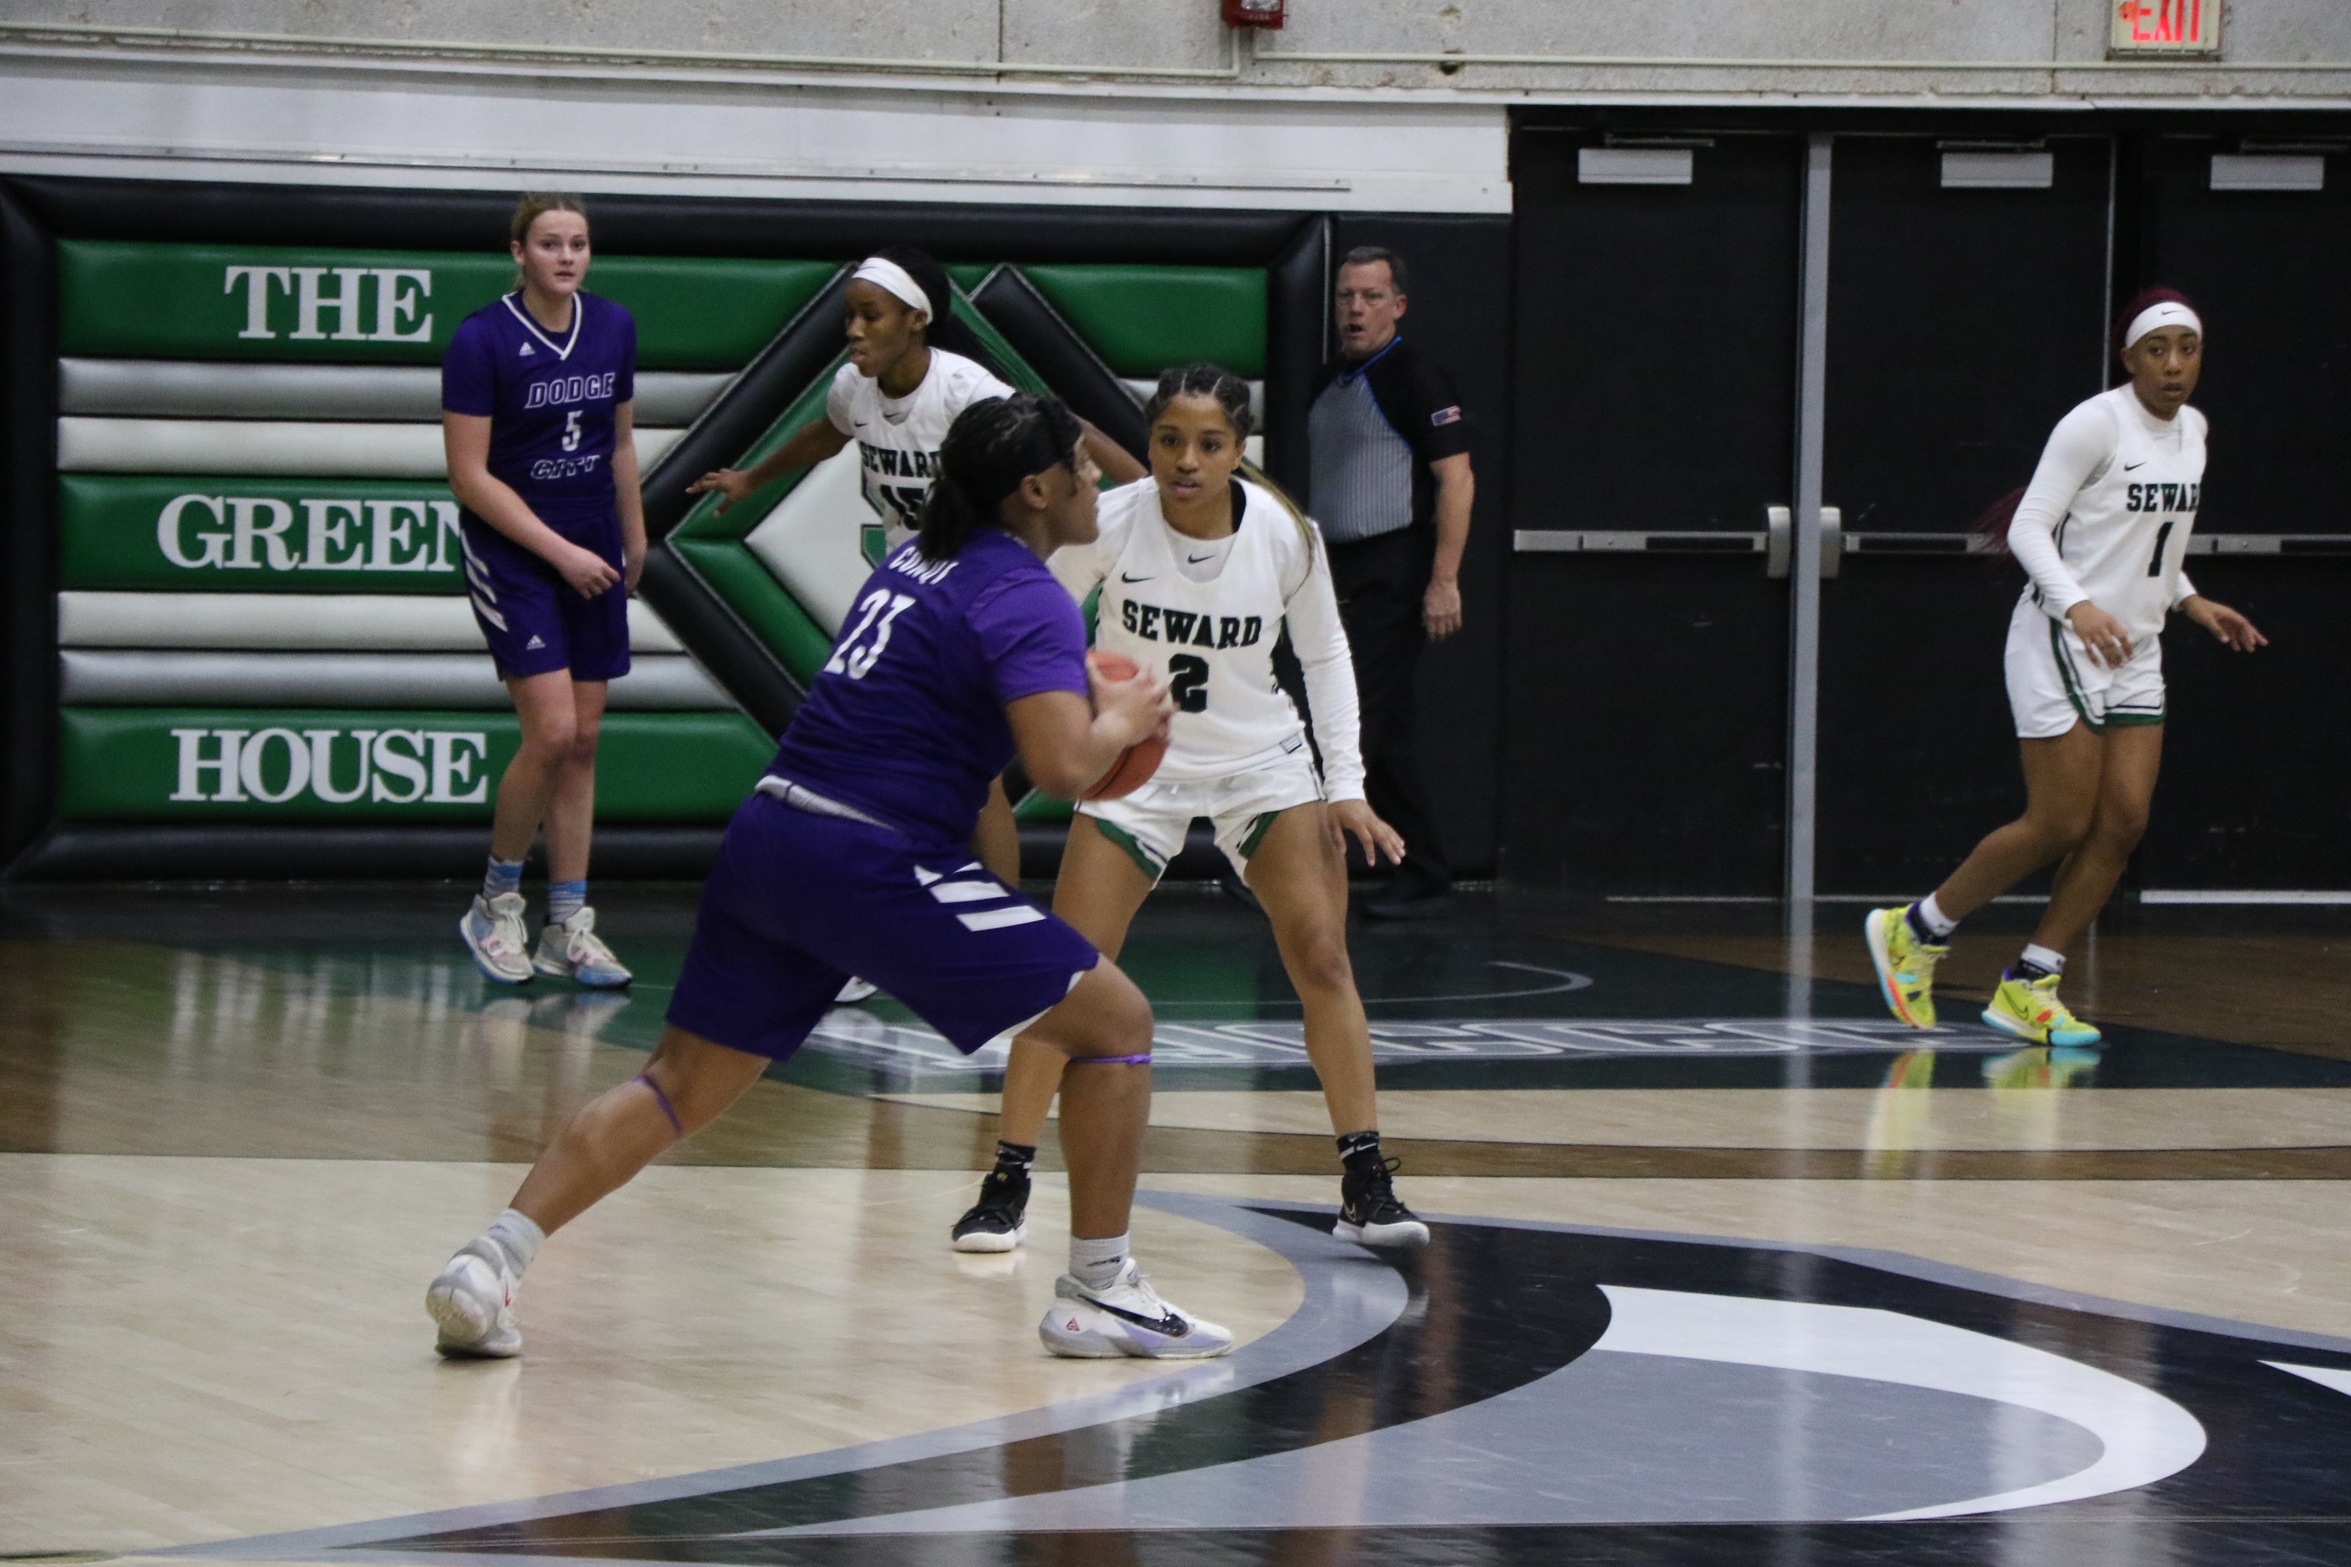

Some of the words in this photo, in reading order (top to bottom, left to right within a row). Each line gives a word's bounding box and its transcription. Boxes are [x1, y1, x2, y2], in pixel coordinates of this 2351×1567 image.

[2132, 0, 2200, 42] EXIT
[224, 265, 433, 341] THE
[524, 372, 616, 409] DODGE
[562, 410, 583, 452] 5
[860, 440, 942, 478] SEWAR
[2147, 521, 2175, 577] 1
[823, 588, 917, 680] 23
[1122, 599, 1262, 650] SEWARD
[1169, 653, 1209, 713] 2
[170, 728, 488, 804] HOUSE
